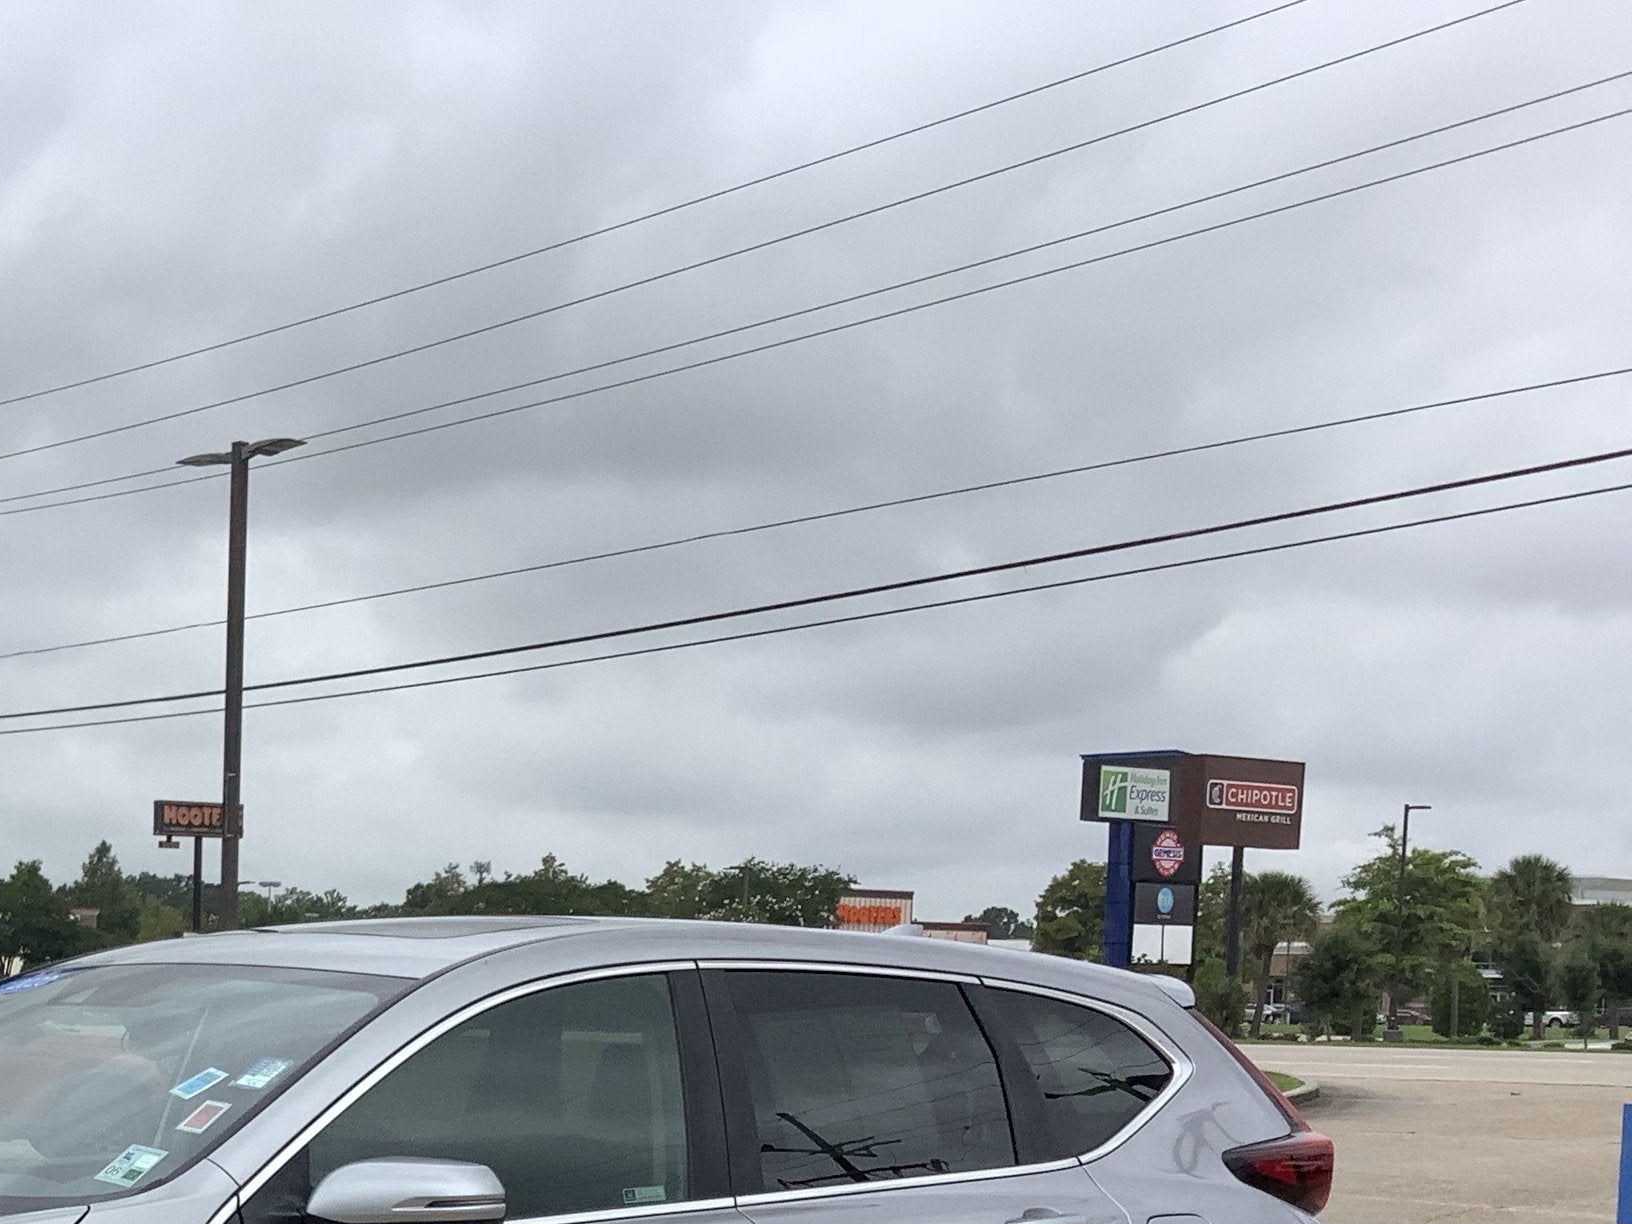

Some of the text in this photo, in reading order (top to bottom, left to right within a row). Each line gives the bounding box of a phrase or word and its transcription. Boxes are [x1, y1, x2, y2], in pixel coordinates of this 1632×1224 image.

[1129, 786, 1166, 803] Express
[1227, 787, 1294, 807] CHIPOTLE
[163, 804, 224, 826] HOOTE
[1236, 813, 1291, 825] MEXICAN GRILL
